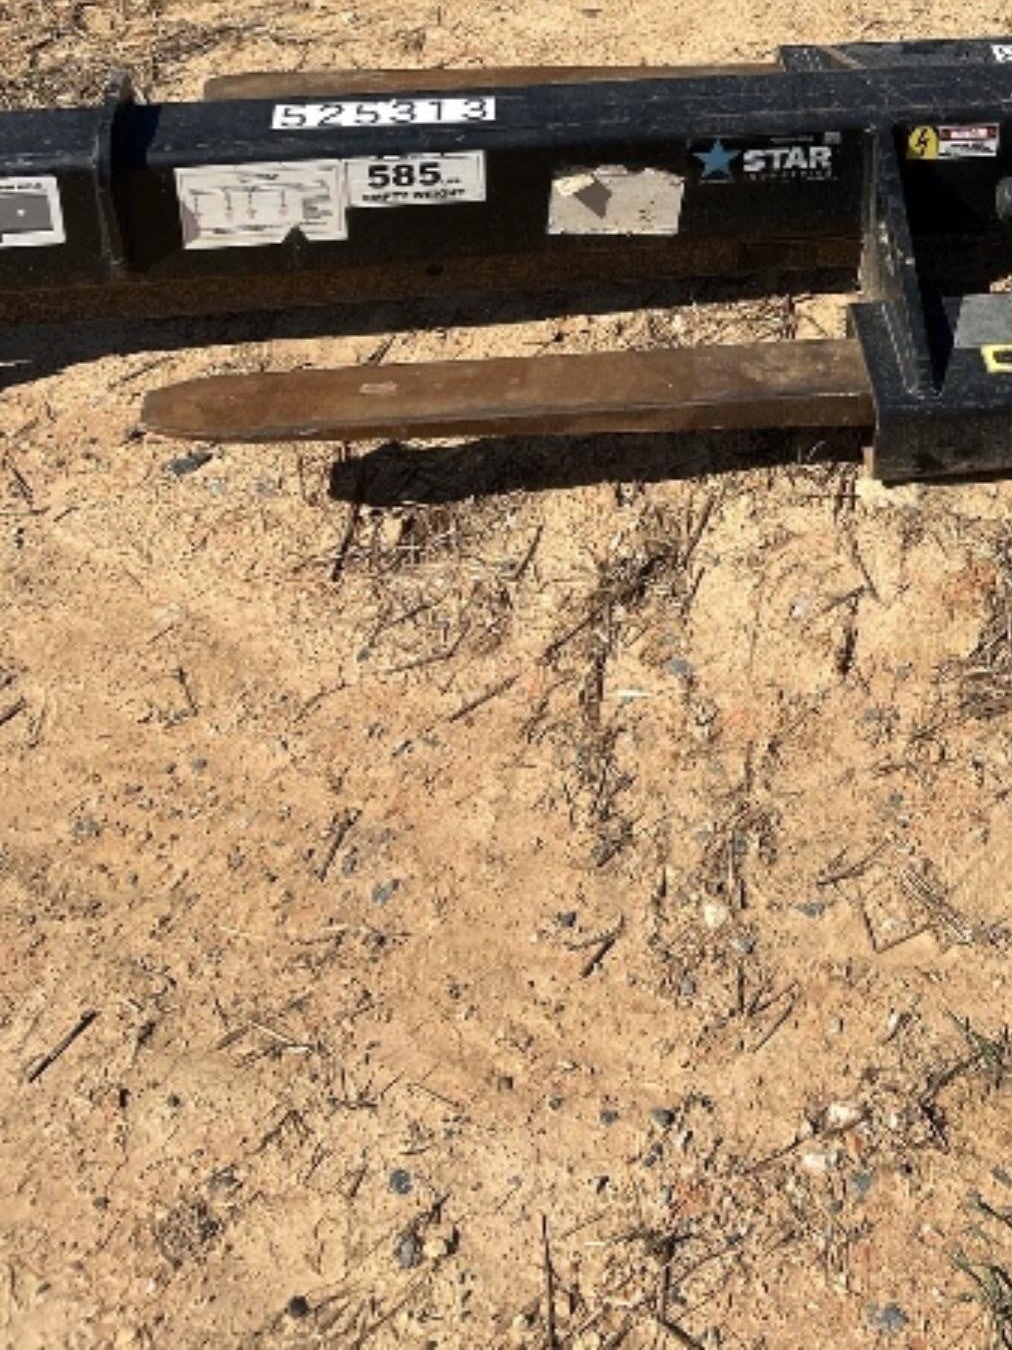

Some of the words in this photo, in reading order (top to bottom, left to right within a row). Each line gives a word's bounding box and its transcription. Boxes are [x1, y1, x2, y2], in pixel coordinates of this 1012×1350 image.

[281, 98, 487, 127] 525313
[743, 146, 832, 171] STAR
[368, 161, 441, 188] 585
